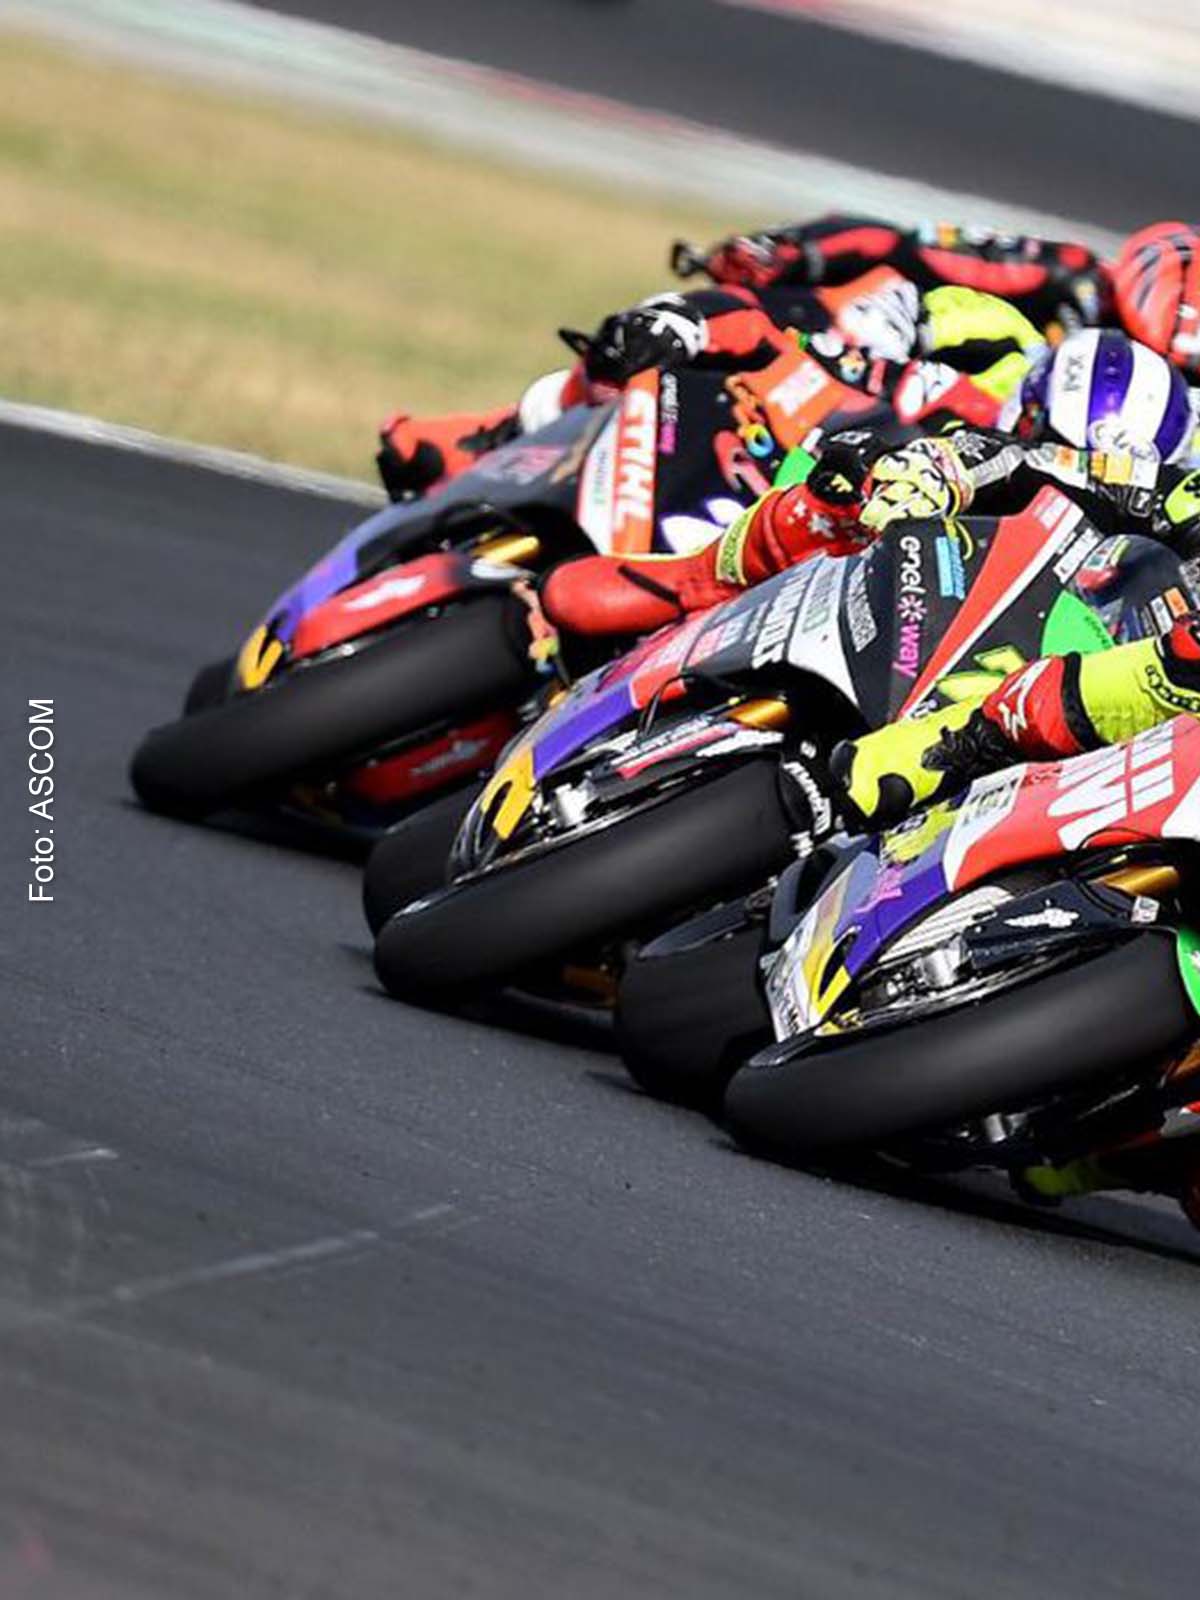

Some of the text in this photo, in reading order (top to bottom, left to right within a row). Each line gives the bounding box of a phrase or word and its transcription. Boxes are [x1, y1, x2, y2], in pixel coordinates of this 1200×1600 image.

[611, 389, 657, 532] STIHL
[892, 535, 927, 678] enel way
